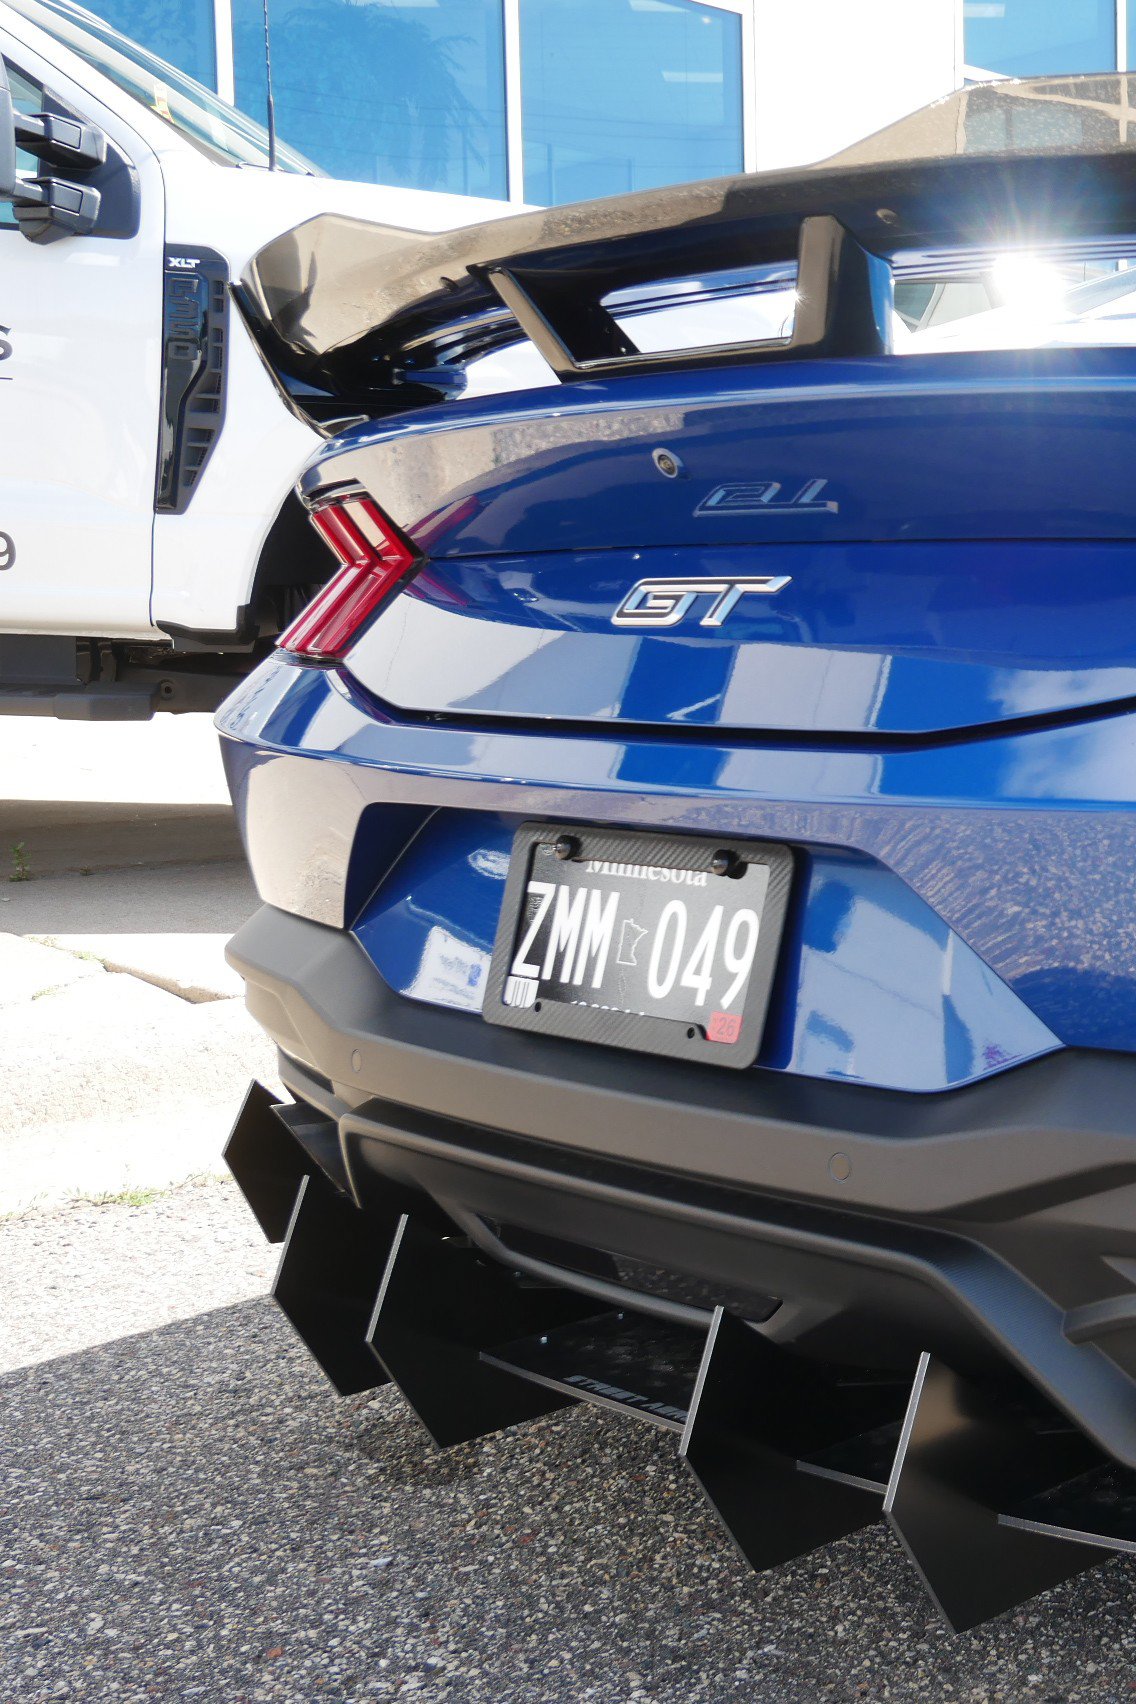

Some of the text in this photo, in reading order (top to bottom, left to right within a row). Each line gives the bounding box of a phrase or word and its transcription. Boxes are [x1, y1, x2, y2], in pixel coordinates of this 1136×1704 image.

[168, 257, 201, 269] XLT
[611, 575, 793, 627] GT
[586, 859, 707, 887] Minnesota
[510, 881, 621, 989] ZMM
[647, 899, 760, 1011] 049
[562, 1374, 650, 1404] STREET
